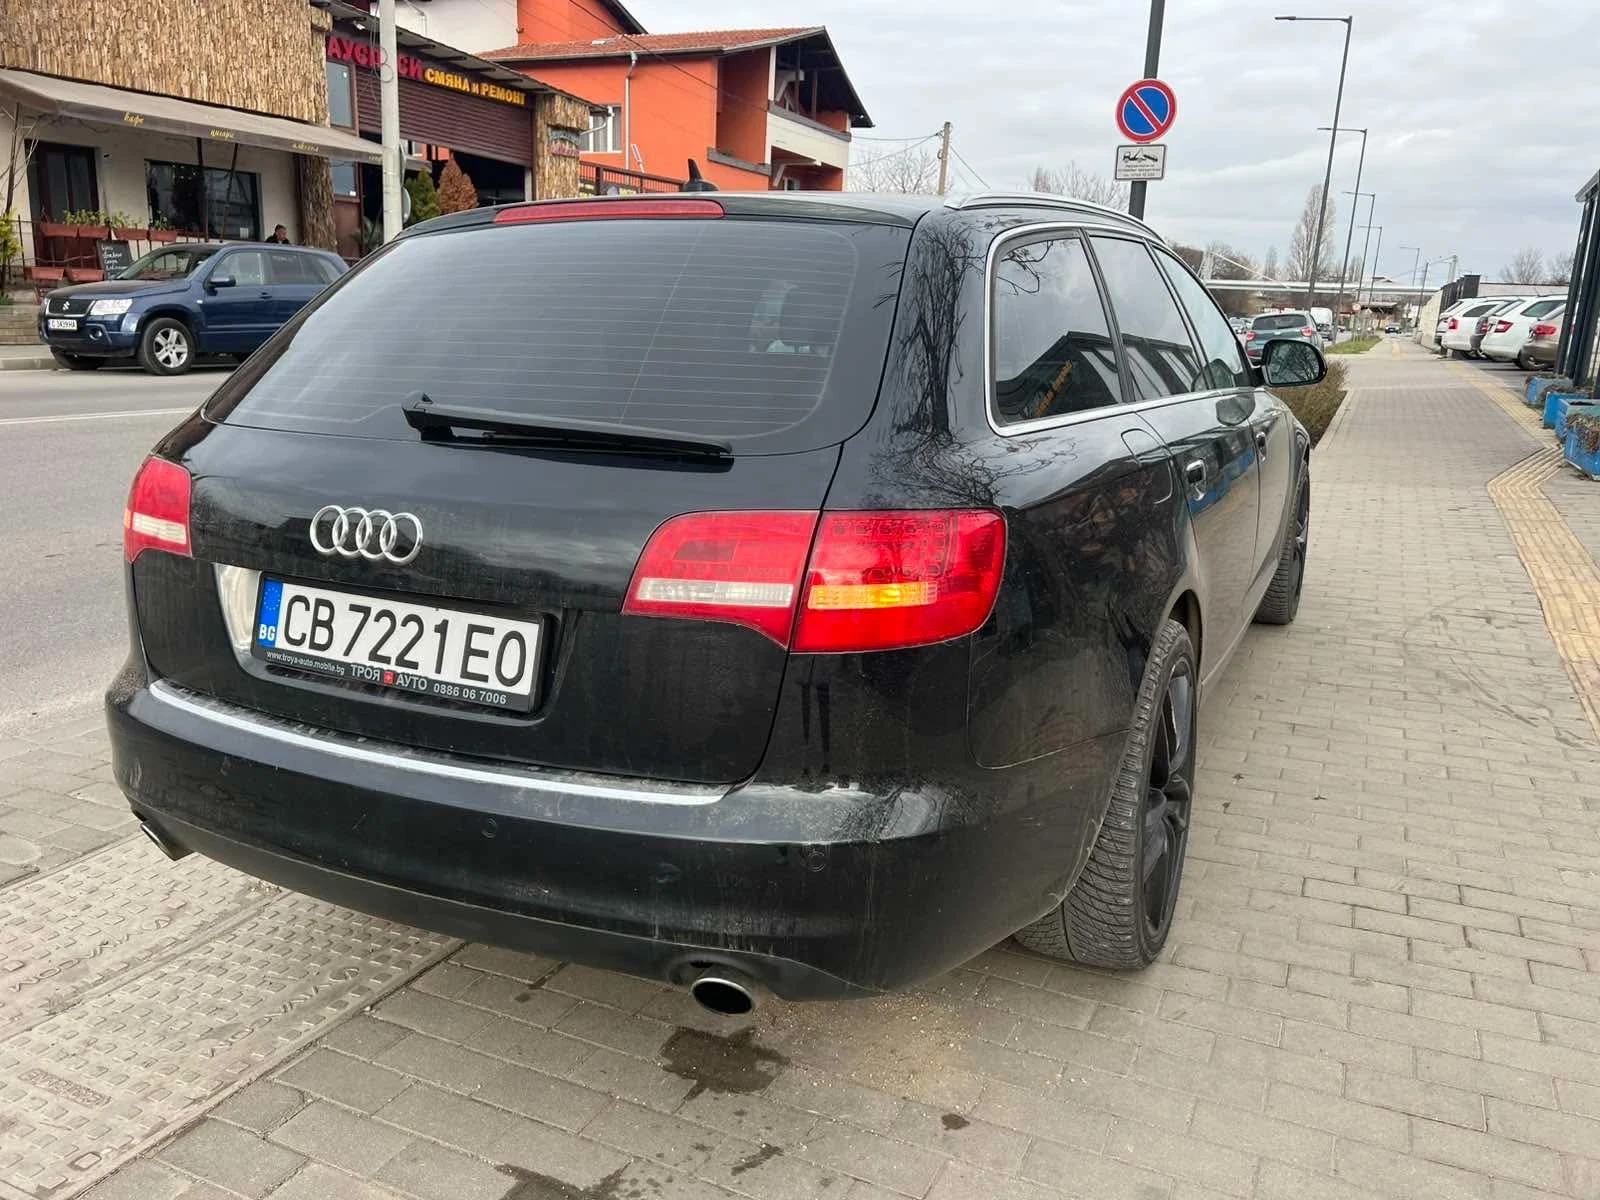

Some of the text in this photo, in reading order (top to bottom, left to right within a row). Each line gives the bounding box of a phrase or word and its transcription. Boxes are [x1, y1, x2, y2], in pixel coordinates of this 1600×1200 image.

[327, 36, 424, 80] АУСПСИ
[425, 68, 471, 92] СМЯНА
[480, 83, 527, 105] РЕМОНТ
[259, 623, 276, 642] BG
[284, 594, 527, 688] CB 7221 EO
[266, 651, 507, 706] www.troya-auto.mobile.bg ТРОЯ АУТО 0886 06 7006
